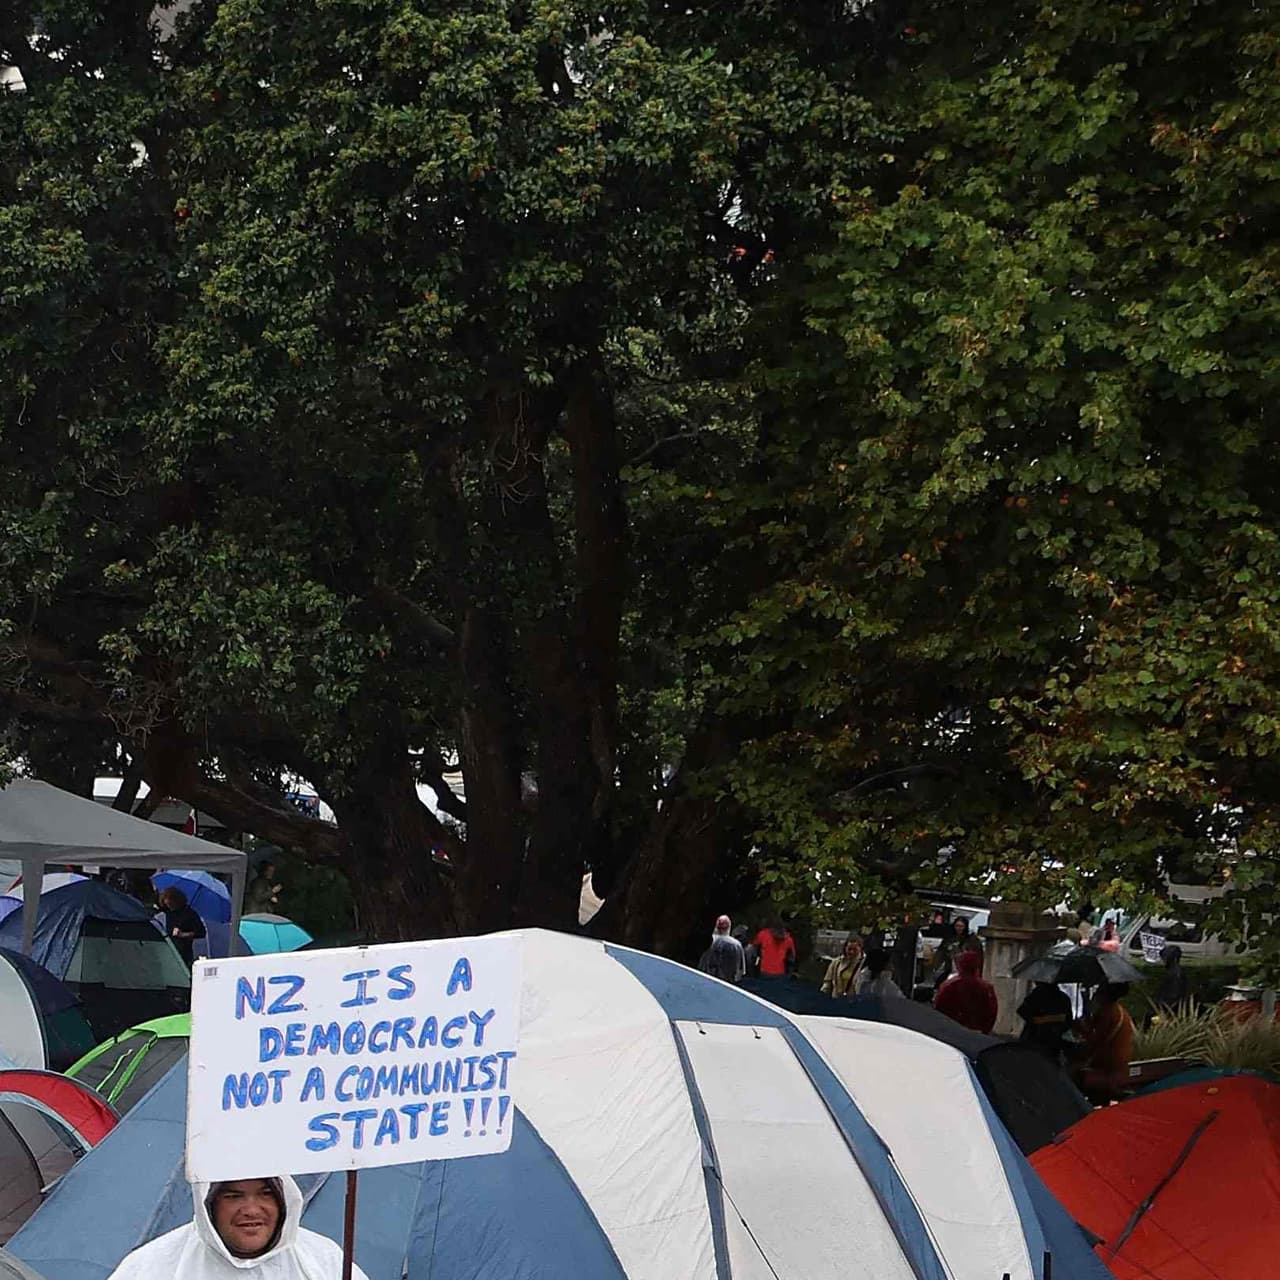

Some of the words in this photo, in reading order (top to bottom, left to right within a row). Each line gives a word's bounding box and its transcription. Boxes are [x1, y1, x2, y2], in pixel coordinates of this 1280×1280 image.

[340, 964, 416, 1008] IS
[446, 957, 473, 996] A
[258, 1008, 496, 1063] DEMOCRACY
[221, 1069, 290, 1111] NOT
[300, 1066, 326, 1102] A
[334, 1051, 518, 1101] COMMUNIST
